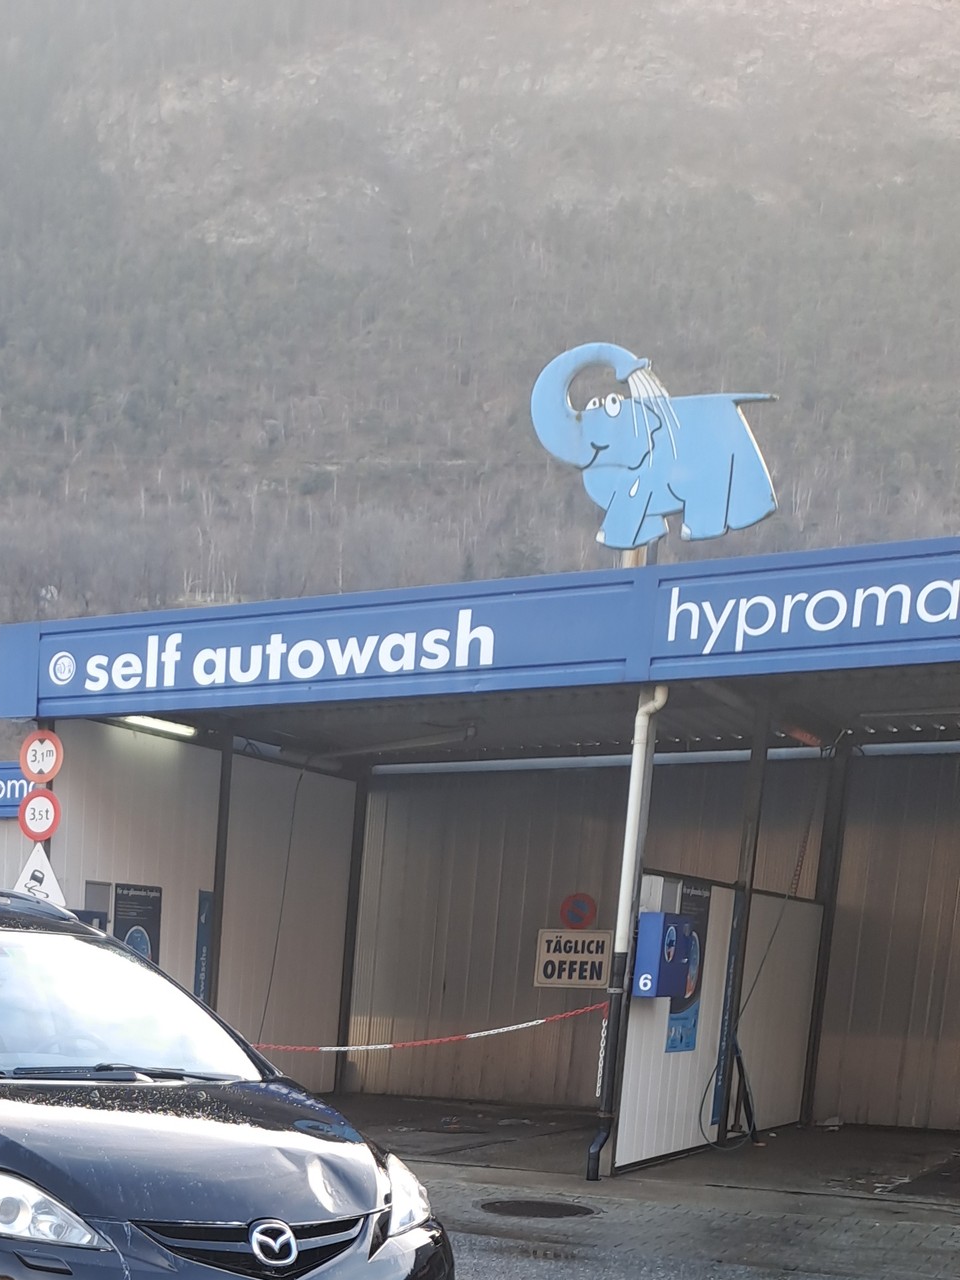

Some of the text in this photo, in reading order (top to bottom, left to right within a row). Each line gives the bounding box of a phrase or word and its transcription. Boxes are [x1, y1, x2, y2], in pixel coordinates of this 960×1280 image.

[668, 580, 960, 653] hyproma
[85, 610, 493, 691] self autowash
[545, 935, 605, 954] TÄGLICH
[543, 960, 603, 980] OFFEN
[639, 974, 652, 991] 6
